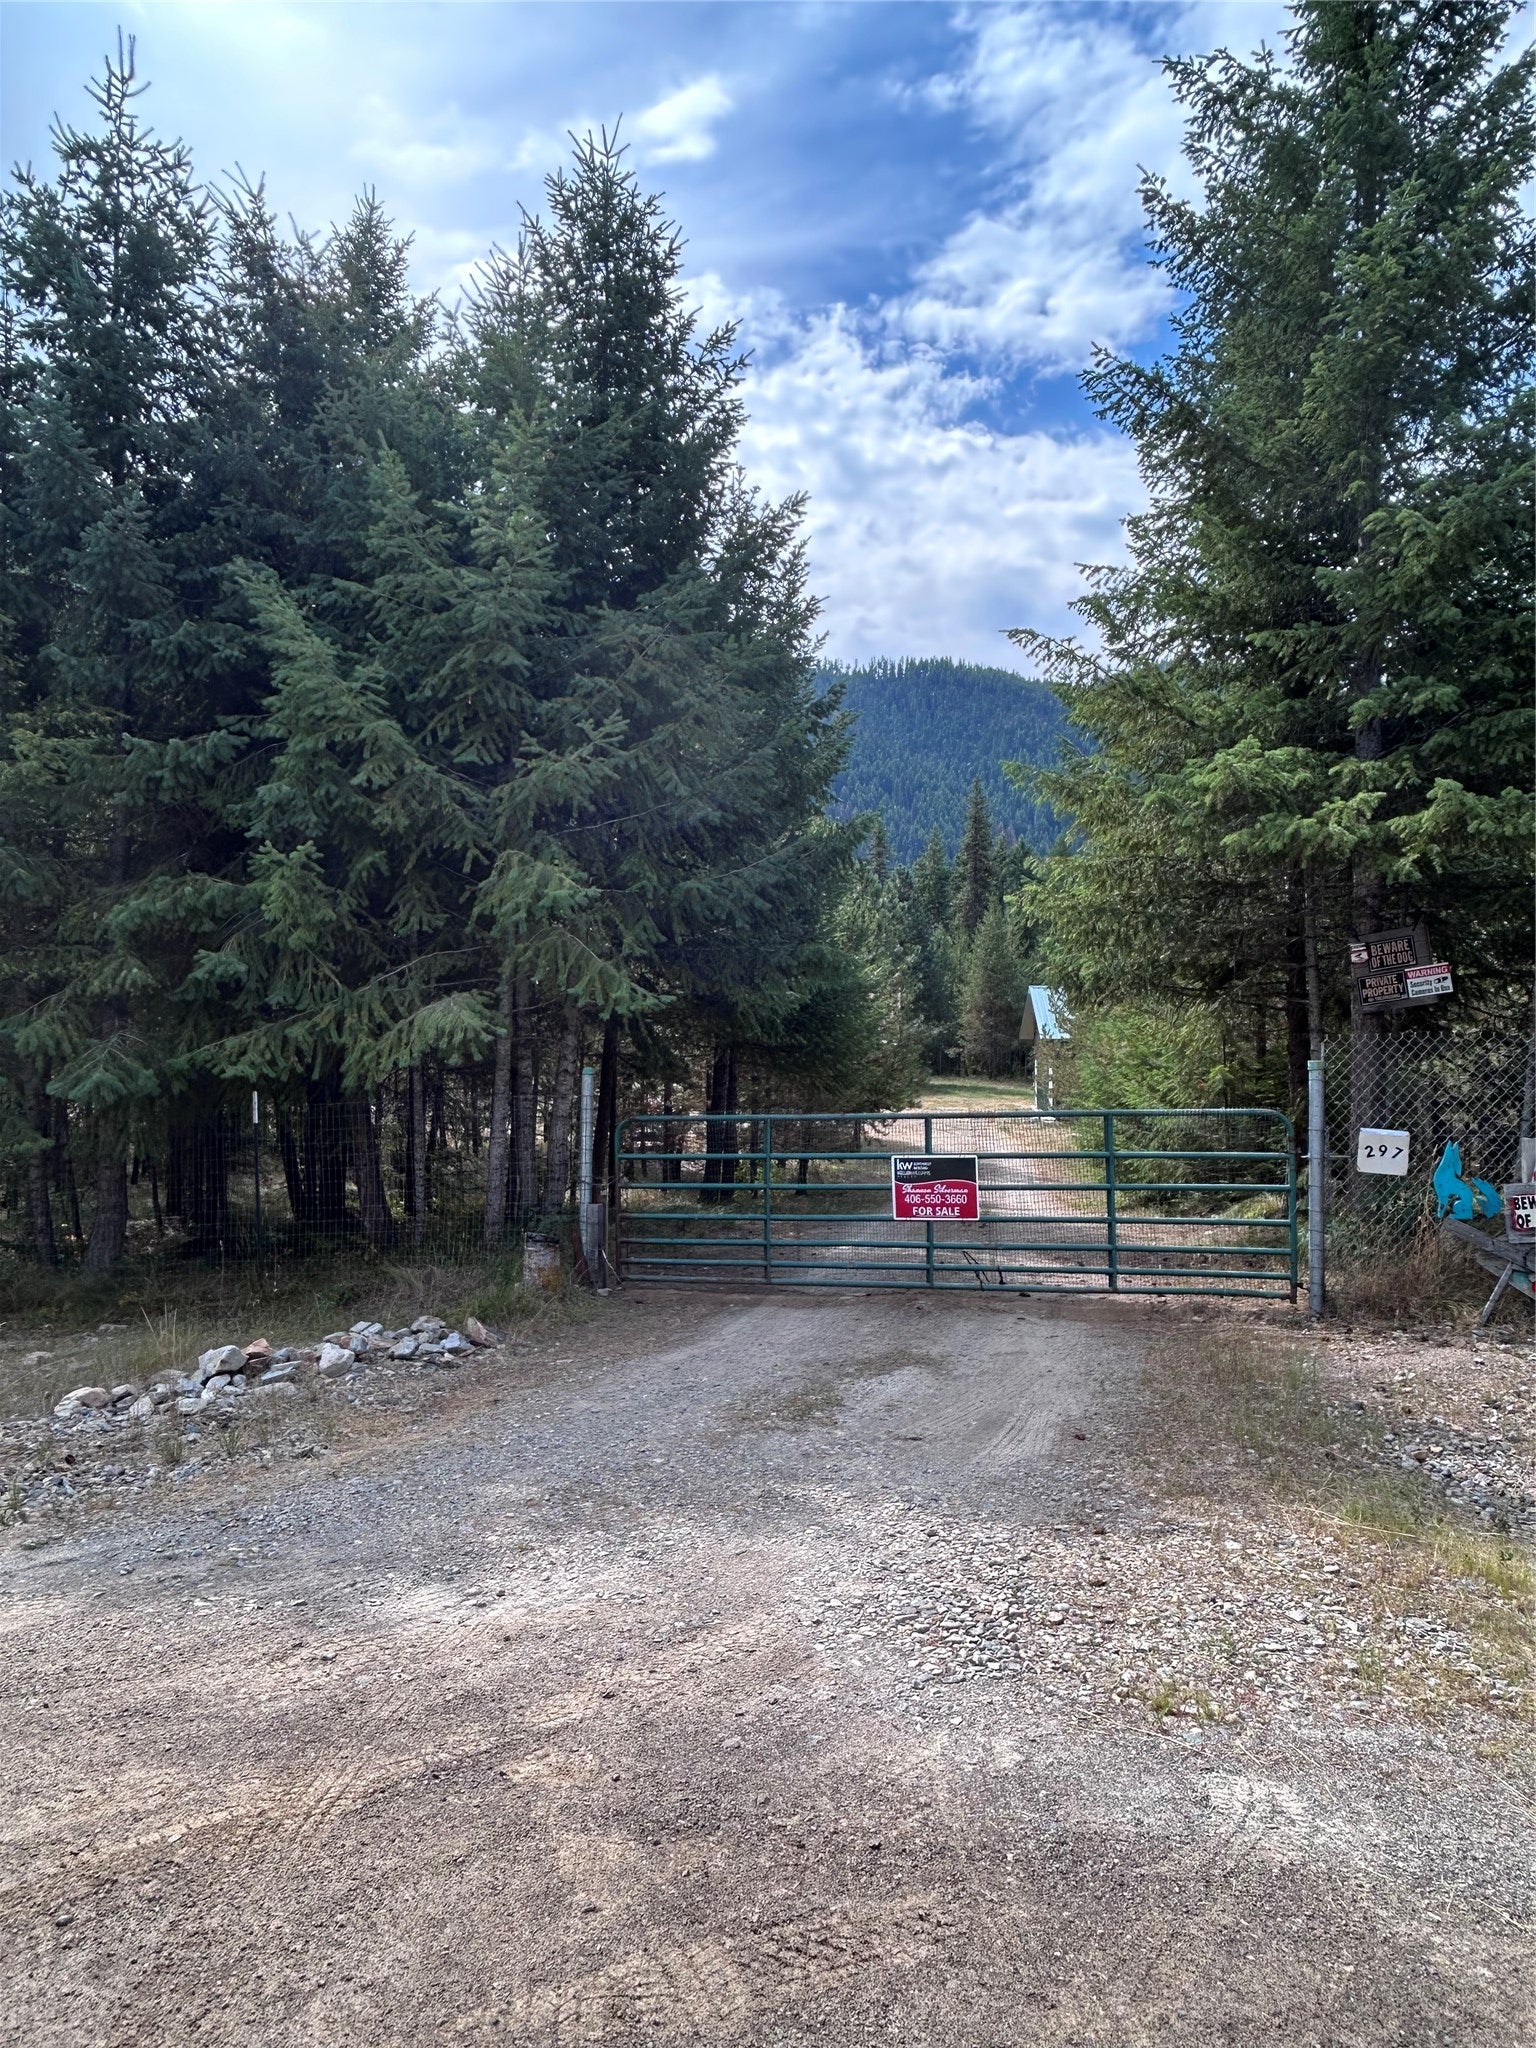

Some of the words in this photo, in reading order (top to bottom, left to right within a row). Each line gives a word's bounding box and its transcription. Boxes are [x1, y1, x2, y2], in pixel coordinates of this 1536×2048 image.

[1371, 939, 1410, 956] BEWARE
[1372, 956, 1380, 968] OF
[1382, 953, 1397, 966] THE
[1397, 951, 1413, 964] DOG
[1407, 966, 1448, 978] WARNING
[1365, 975, 1398, 988] PRIVATE
[1410, 979, 1433, 988] Security
[1362, 983, 1404, 998] PROPERTY
[1364, 1144, 1404, 1159] 297
[896, 1159, 913, 1171] kw
[904, 1194, 967, 1204] 406-550-3660
[912, 1206, 933, 1216] FOR
[935, 1206, 961, 1216] SALE
[1517, 1214, 1531, 1228] OF
